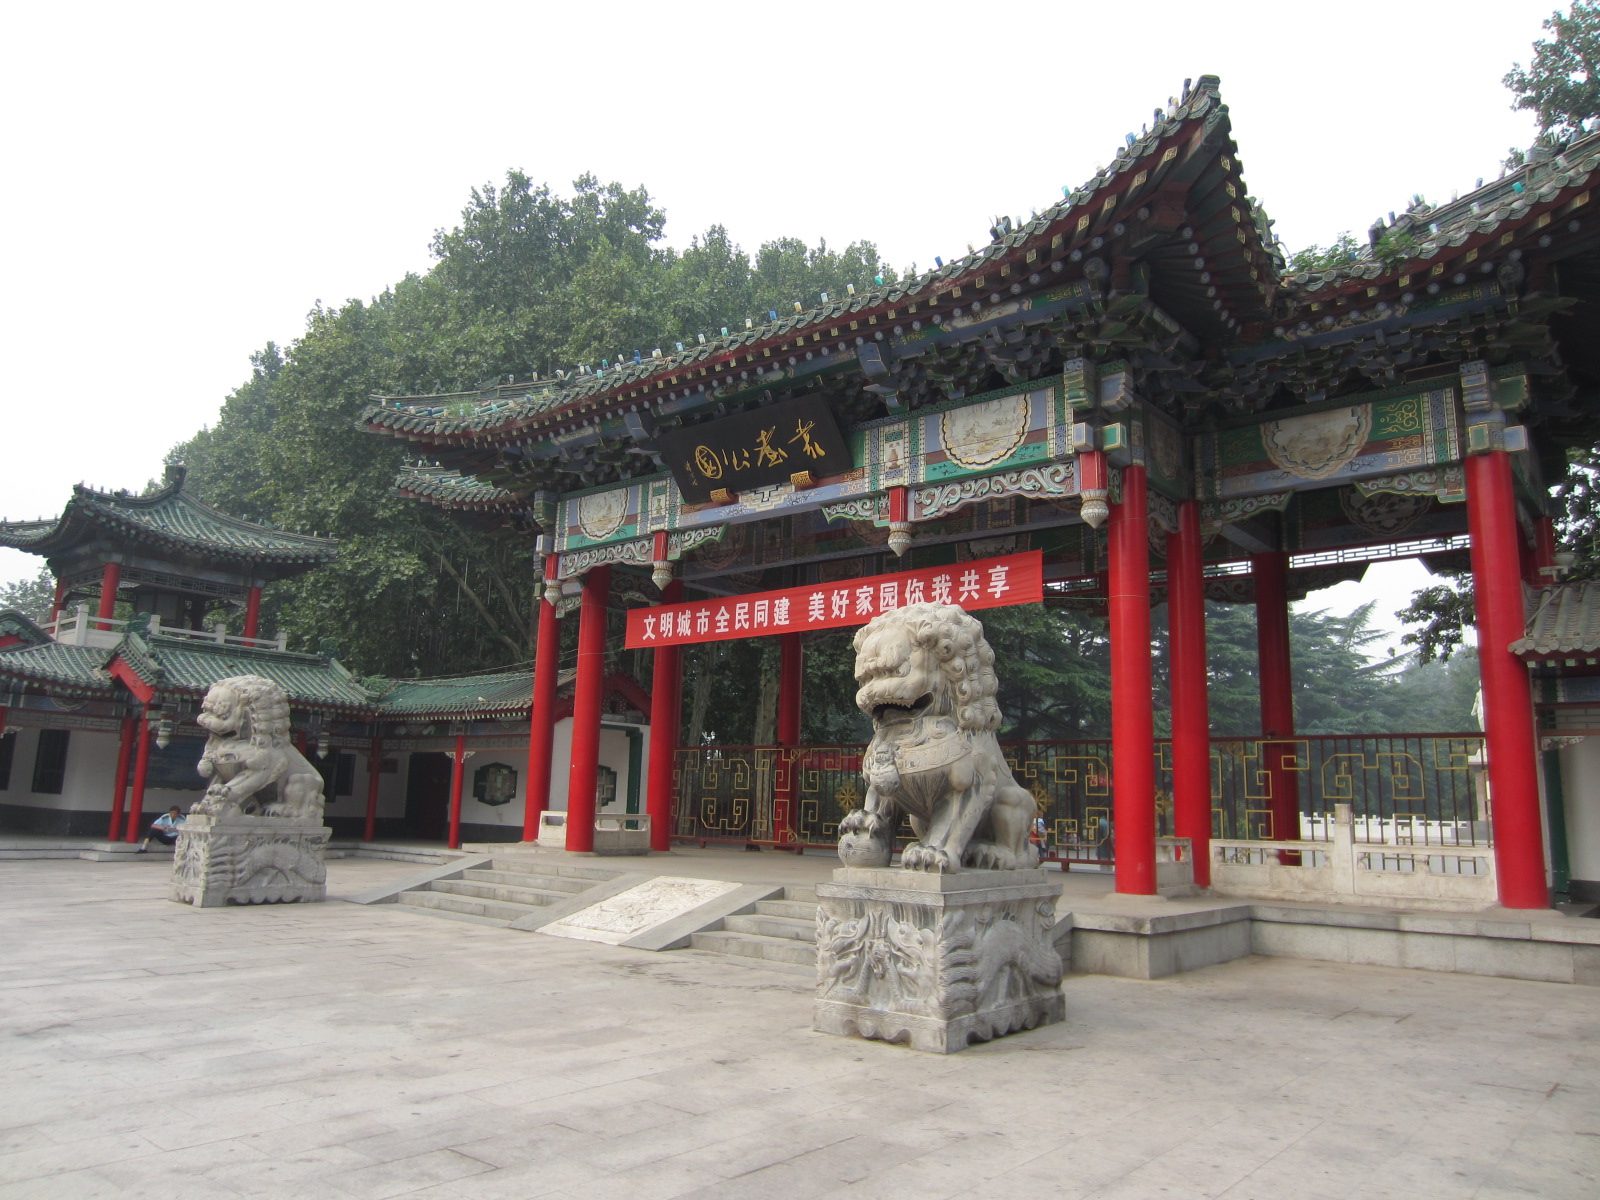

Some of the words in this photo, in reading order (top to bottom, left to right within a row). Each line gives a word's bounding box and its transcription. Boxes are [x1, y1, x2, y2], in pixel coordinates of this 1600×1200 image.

[642, 596, 791, 641] 文明城市全民同建
[808, 565, 1010, 622] 美好家园你我共享
